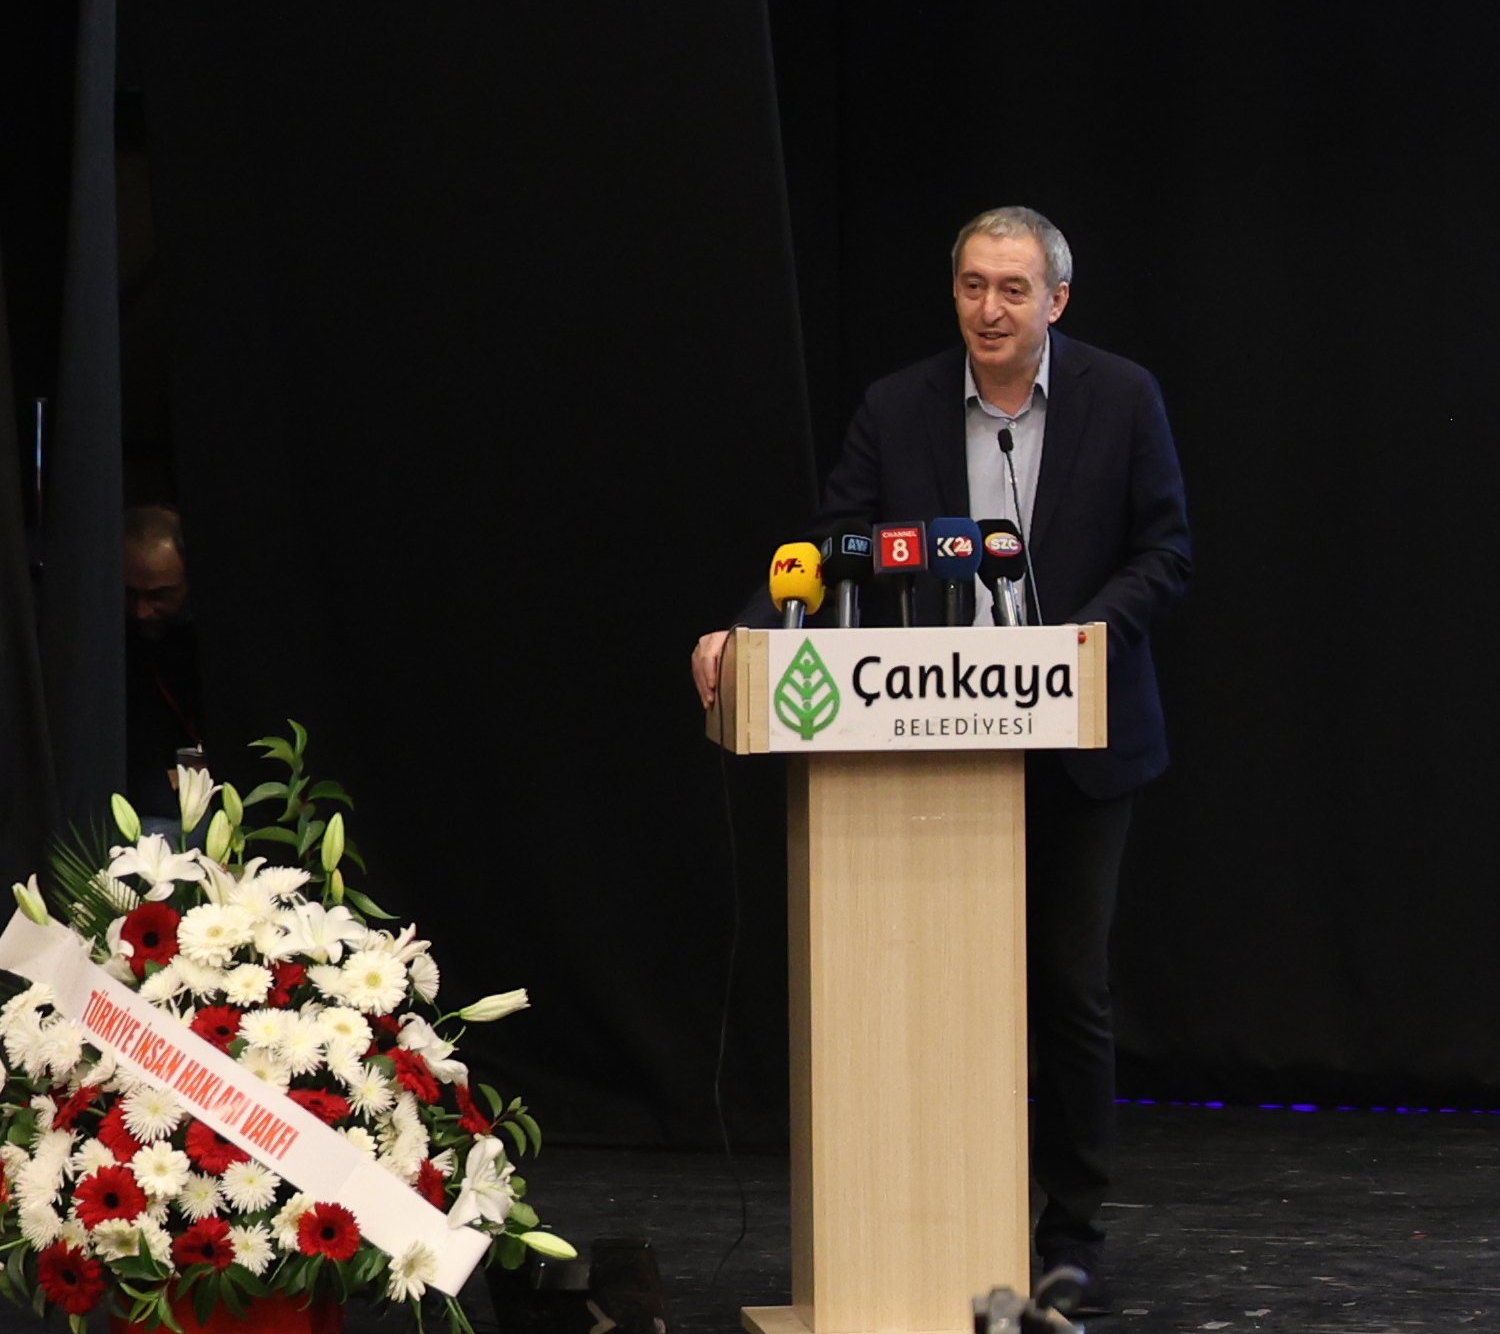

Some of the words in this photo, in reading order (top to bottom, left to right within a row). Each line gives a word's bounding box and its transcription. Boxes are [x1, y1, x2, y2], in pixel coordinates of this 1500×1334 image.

[882, 530, 917, 539] CHANNEL
[990, 537, 1019, 551] SZC
[892, 539, 910, 563] 8
[852, 652, 1074, 708] Çankaya
[894, 713, 1034, 736] BELEDİYESİ
[82, 989, 141, 1054] TÜRKİYE
[129, 1022, 187, 1084] İNSAN
[239, 1104, 300, 1161] VAKFI
